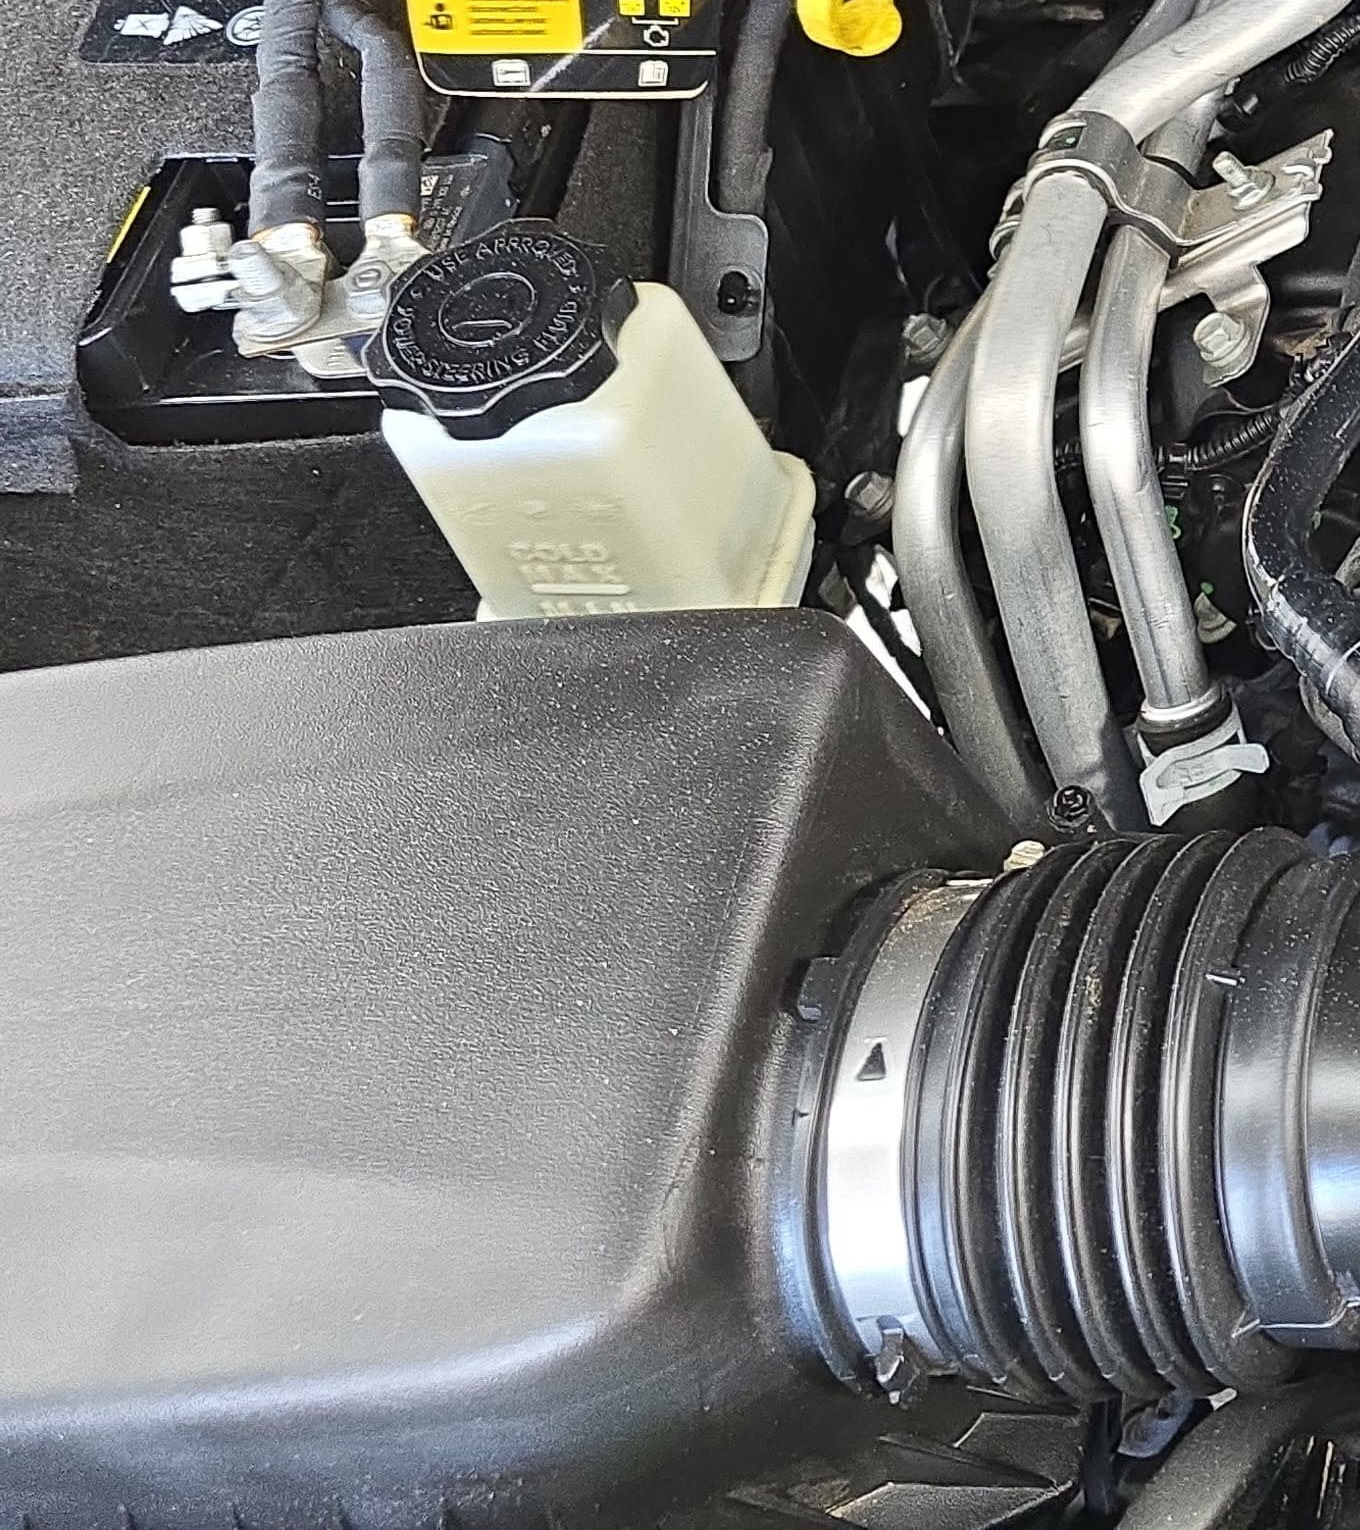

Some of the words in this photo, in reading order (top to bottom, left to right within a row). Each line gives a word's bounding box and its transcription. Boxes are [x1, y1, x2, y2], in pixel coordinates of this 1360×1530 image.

[424, 250, 470, 281] USE
[475, 236, 579, 277] APPROVED
[423, 347, 531, 382] STEERING
[533, 299, 580, 352] FLUID
[507, 542, 610, 563] COLD
[518, 564, 623, 583] MAX
